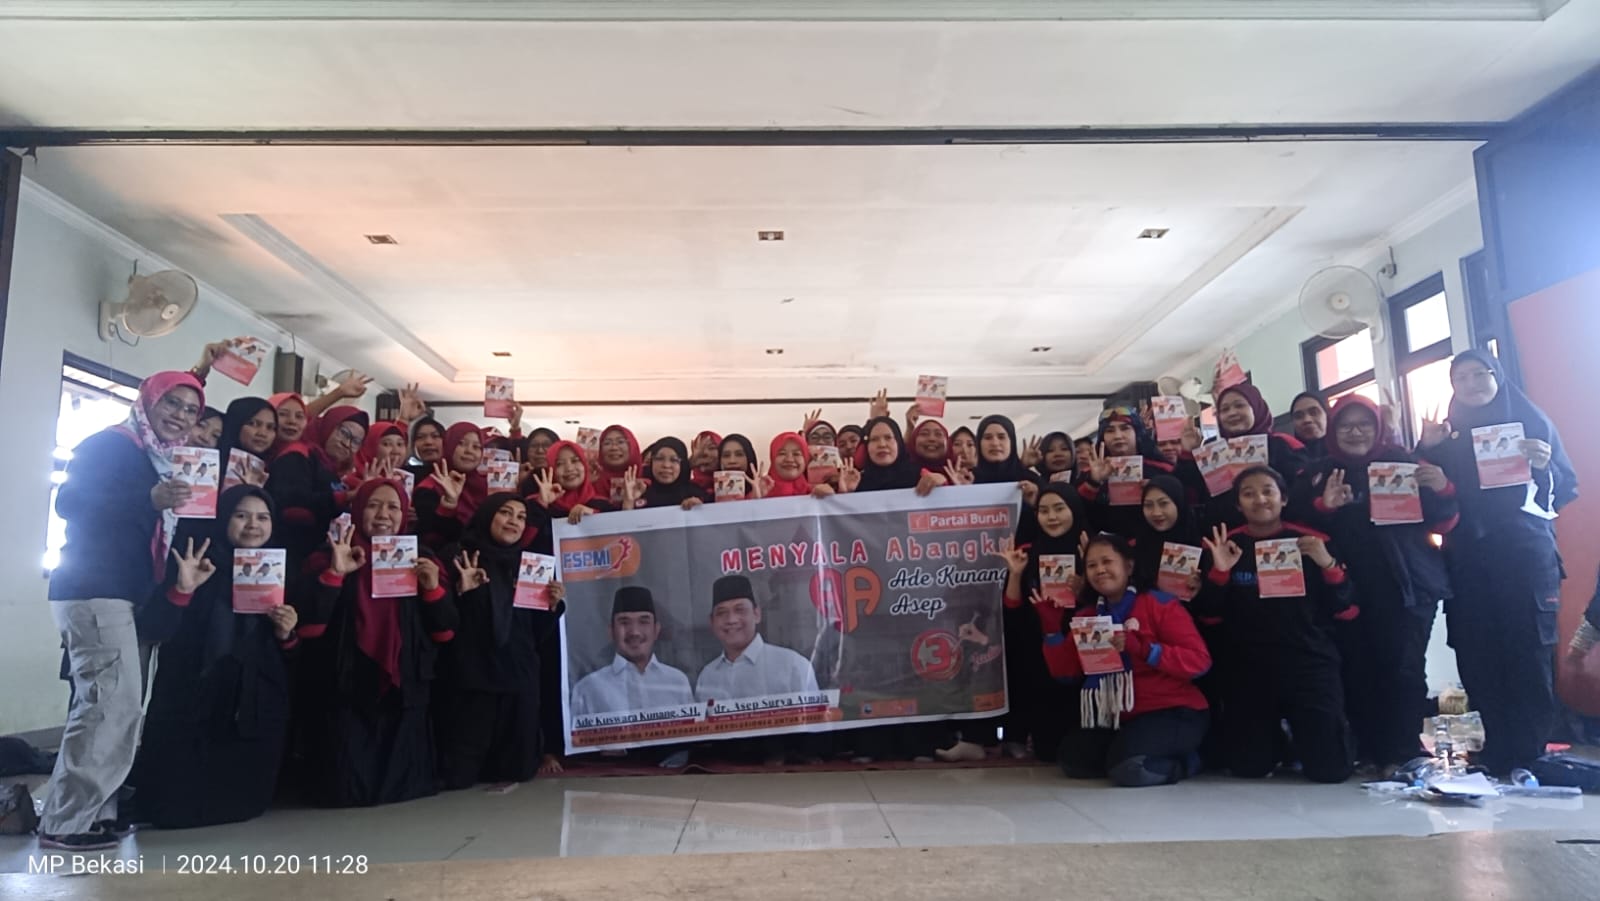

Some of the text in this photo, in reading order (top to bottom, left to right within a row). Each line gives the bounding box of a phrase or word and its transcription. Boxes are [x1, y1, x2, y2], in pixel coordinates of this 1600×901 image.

[930, 511, 1008, 527] Partai Buruh
[563, 548, 610, 569] FSPMI
[720, 539, 868, 574] MENYALA
[888, 567, 933, 590] Ade
[890, 593, 946, 620] Asep
[734, 701, 759, 712] Asep
[761, 697, 793, 709] Surya
[797, 692, 830, 705] Atmaja
[575, 717, 593, 729] Ade
[595, 714, 638, 727] Kuswara
